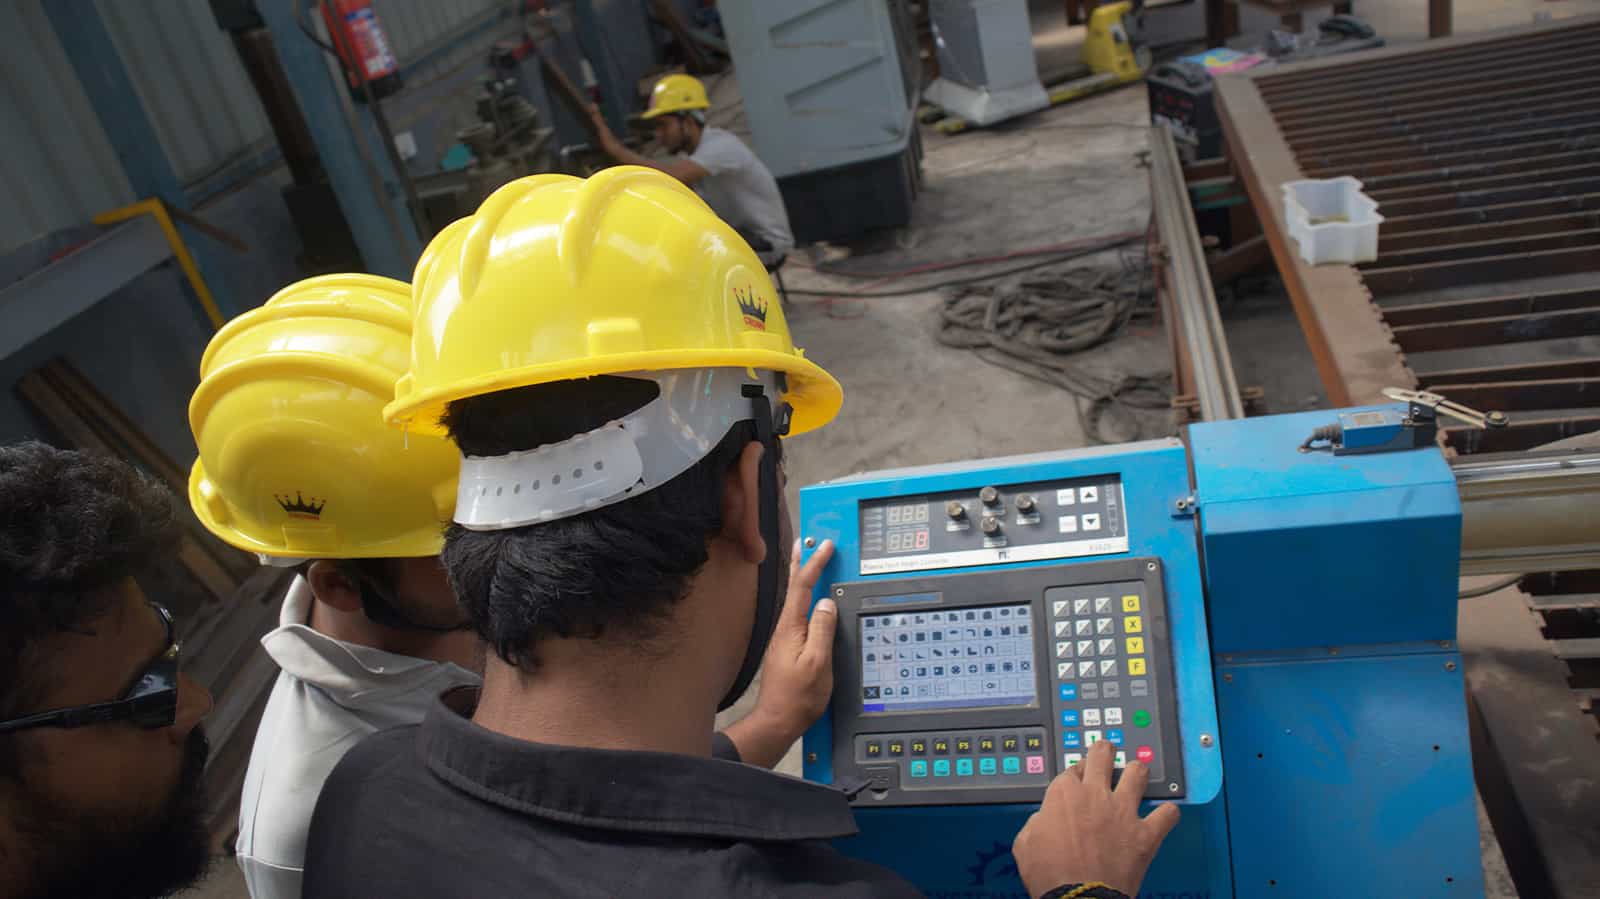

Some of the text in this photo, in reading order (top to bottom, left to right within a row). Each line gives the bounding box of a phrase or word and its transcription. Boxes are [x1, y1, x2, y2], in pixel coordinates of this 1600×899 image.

[1127, 599, 1136, 608] G
[1129, 620, 1138, 629] X
[1131, 641, 1139, 650] Y
[868, 738, 1040, 753] F1 F2 F3 F4 F5 F6 F7 F8
